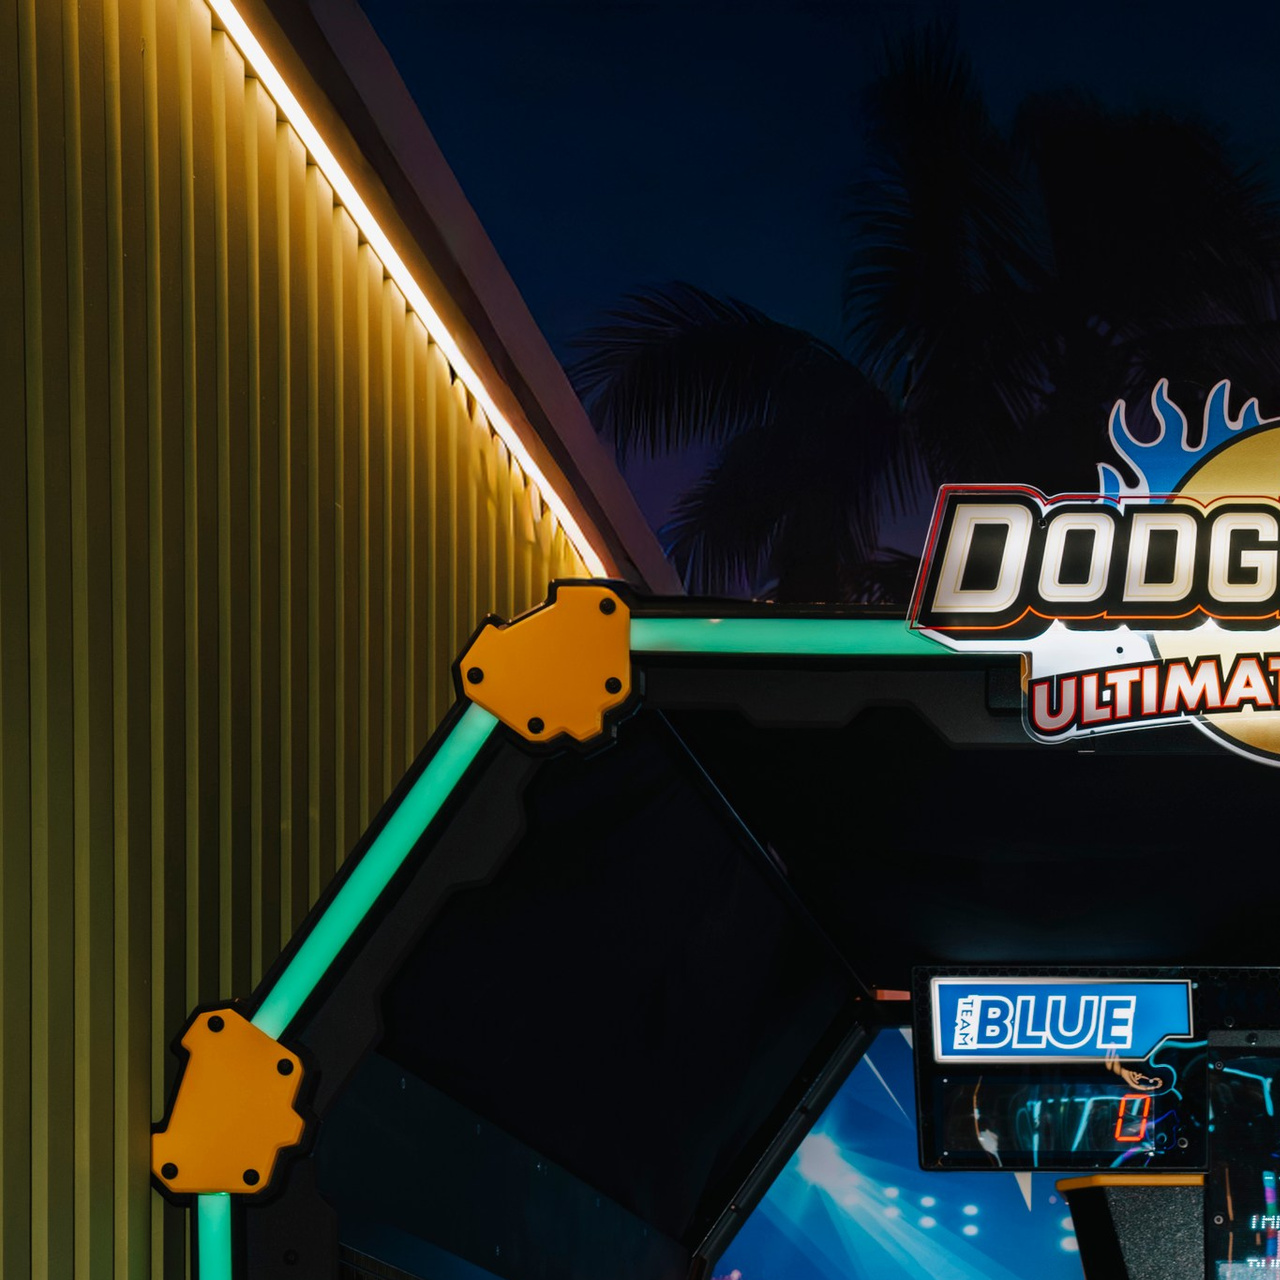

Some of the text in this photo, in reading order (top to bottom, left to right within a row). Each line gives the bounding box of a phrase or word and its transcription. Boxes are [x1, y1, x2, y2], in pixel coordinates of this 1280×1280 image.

[957, 998, 974, 1047] TEAM
[976, 995, 1137, 1050] BLUE
[1115, 1093, 1151, 1142] 0
